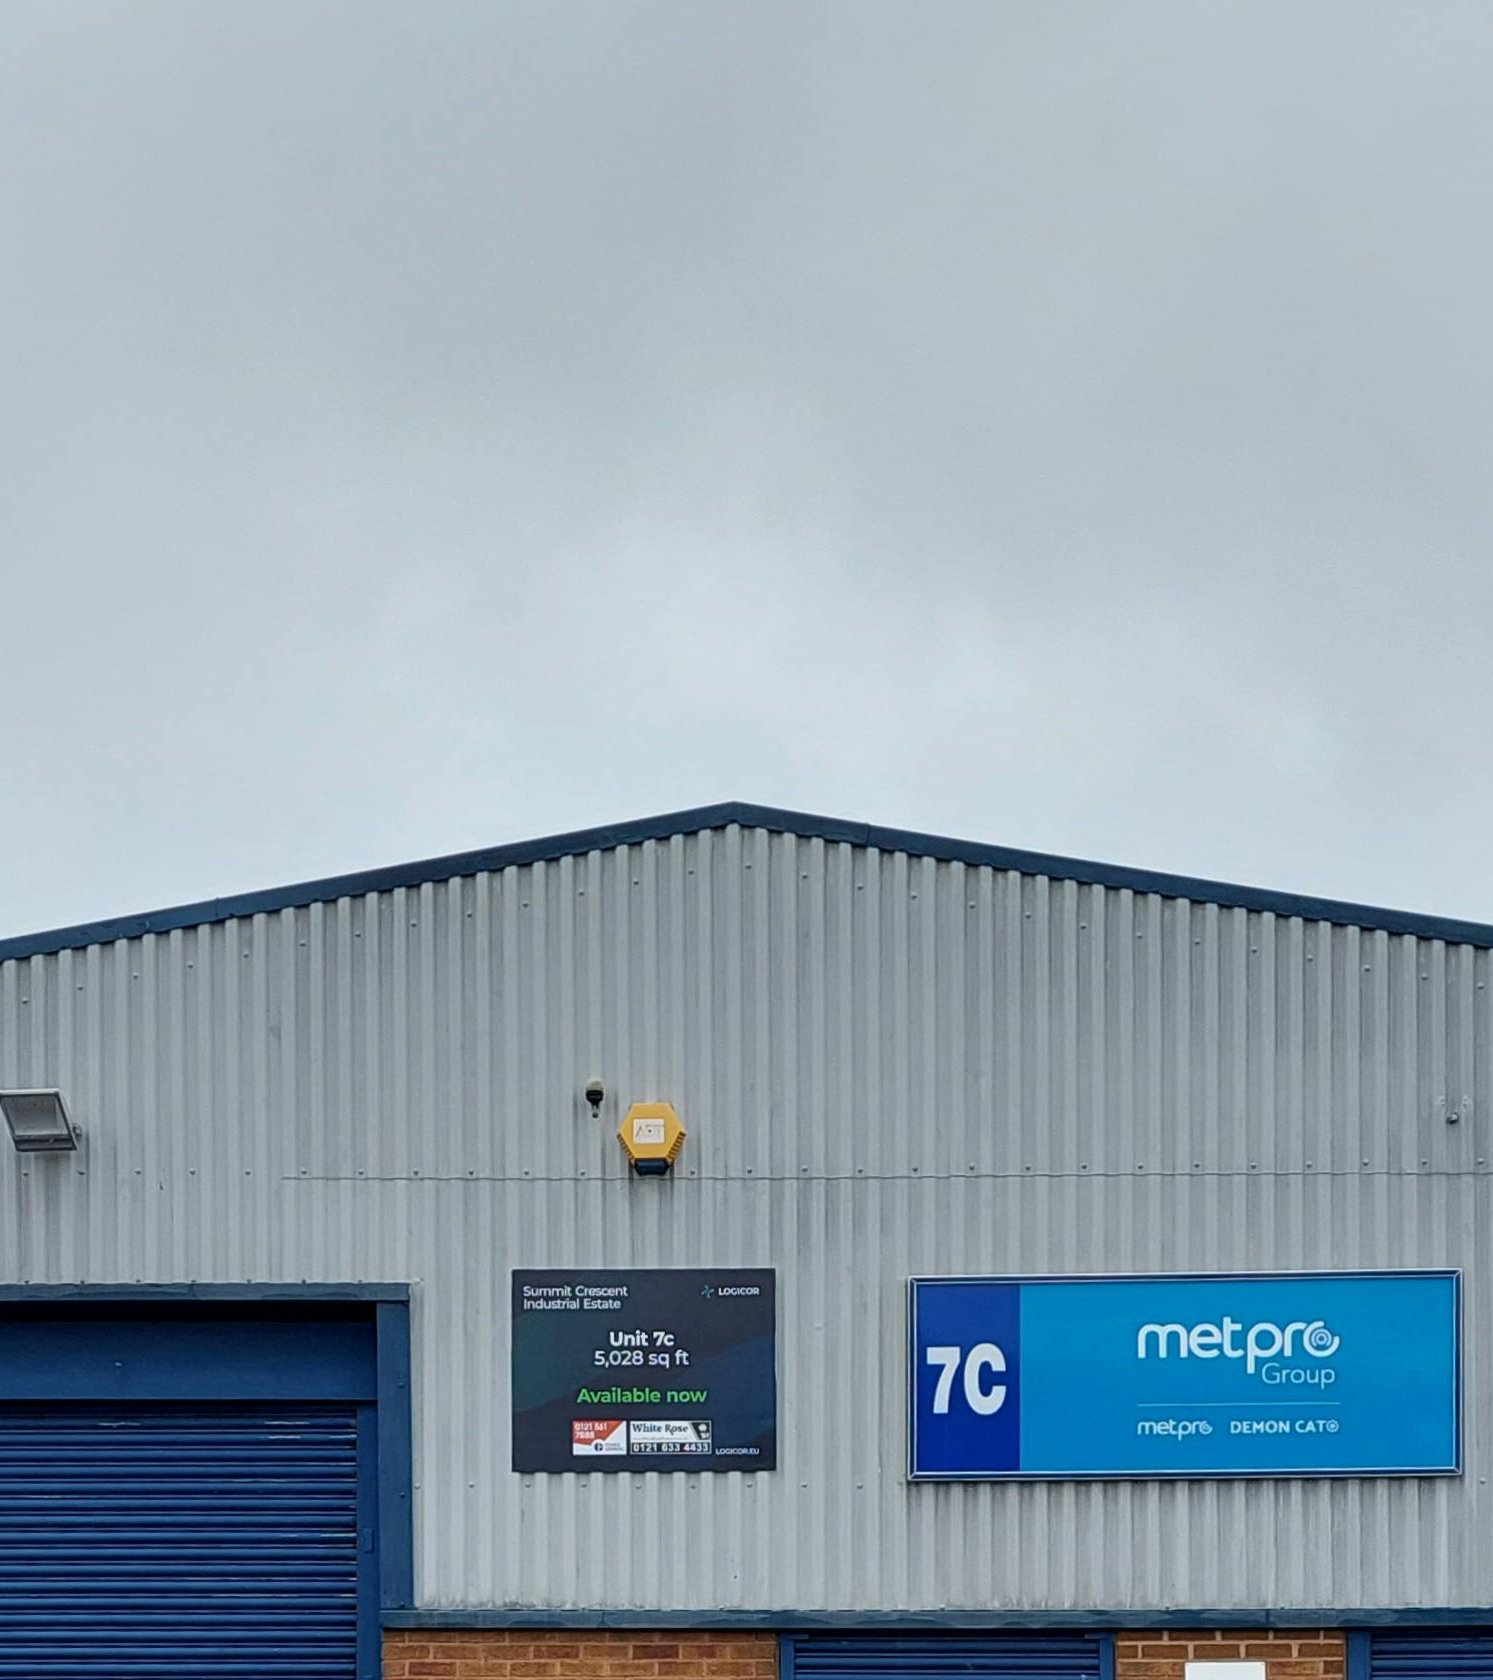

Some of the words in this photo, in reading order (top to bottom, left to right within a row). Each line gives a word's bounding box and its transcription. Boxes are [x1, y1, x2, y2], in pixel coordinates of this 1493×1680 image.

[523, 1285, 572, 1297] Summit
[575, 1286, 628, 1297] Crescent
[718, 1287, 760, 1296] LOGICOR
[523, 1299, 580, 1309] Industrial
[584, 1299, 621, 1309] Estate
[610, 1331, 648, 1346] Unit
[652, 1332, 674, 1346] 7c
[1137, 1316, 1340, 1374] metpro
[594, 1351, 643, 1367] 5,028
[648, 1354, 670, 1368] sq
[675, 1350, 690, 1365] ft
[925, 1342, 1007, 1416] 7C
[1261, 1362, 1335, 1389] Group
[577, 1388, 661, 1403] Available
[667, 1391, 707, 1403] now
[632, 1424, 662, 1432] White
[665, 1424, 688, 1436] Rose
[1137, 1419, 1213, 1441] metpro
[1230, 1420, 1291, 1434] DEMON
[633, 1443, 657, 1452] 0121
[684, 1443, 708, 1451] 4433
